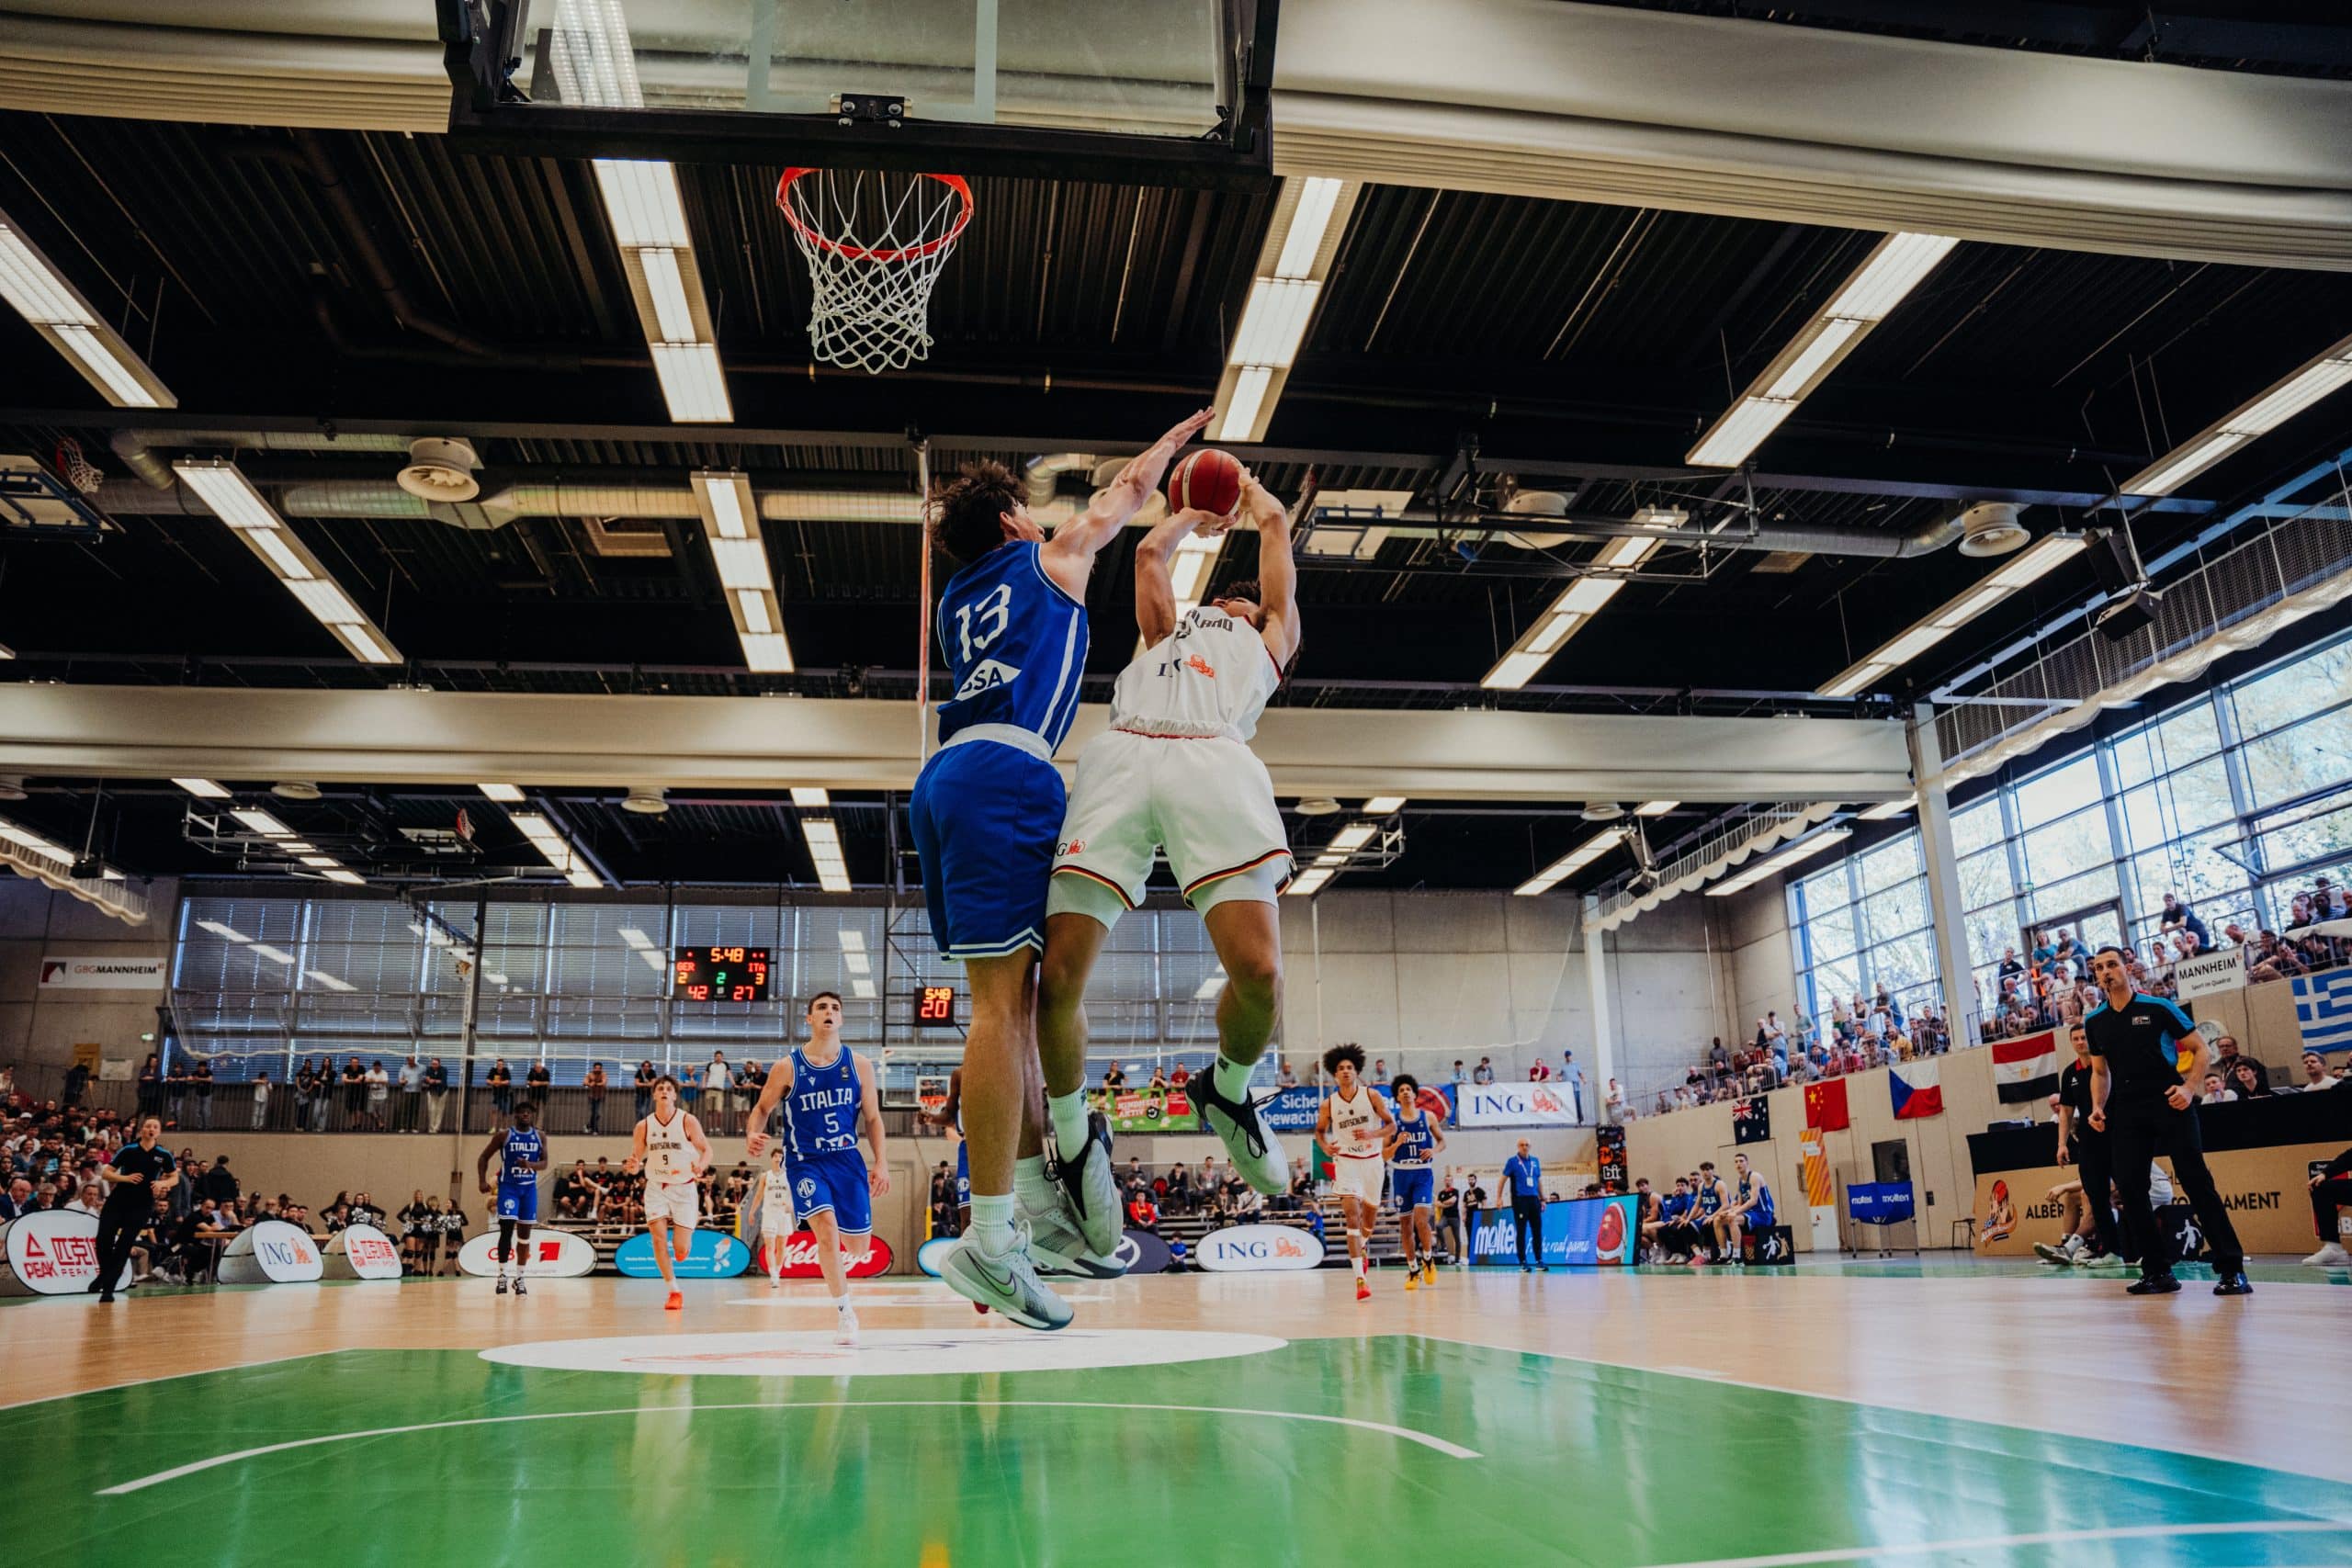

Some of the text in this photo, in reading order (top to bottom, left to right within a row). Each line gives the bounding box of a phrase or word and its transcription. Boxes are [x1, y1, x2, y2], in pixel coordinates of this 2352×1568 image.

[956, 583, 1012, 663] 13
[676, 962, 695, 972] GER
[748, 963, 766, 973] ITA
[2178, 957, 2236, 980] MANNHEIM
[678, 972, 688, 984] 2
[717, 972, 727, 985] 2
[755, 973, 764, 985] 3
[687, 985, 708, 999] 42
[733, 986, 753, 1000] 27
[921, 1000, 947, 1018] 20
[799, 1088, 853, 1111] ITALIA
[1474, 1094, 1523, 1114] ING
[824, 1112, 840, 1134] 5
[510, 1142, 538, 1152] ITALIA
[1408, 1145, 1417, 1156] 11
[662, 1154, 669, 1165] 9
[261, 1242, 292, 1265] ING
[1217, 1241, 1267, 1259] ING
[23, 1261, 57, 1280] PEAK
